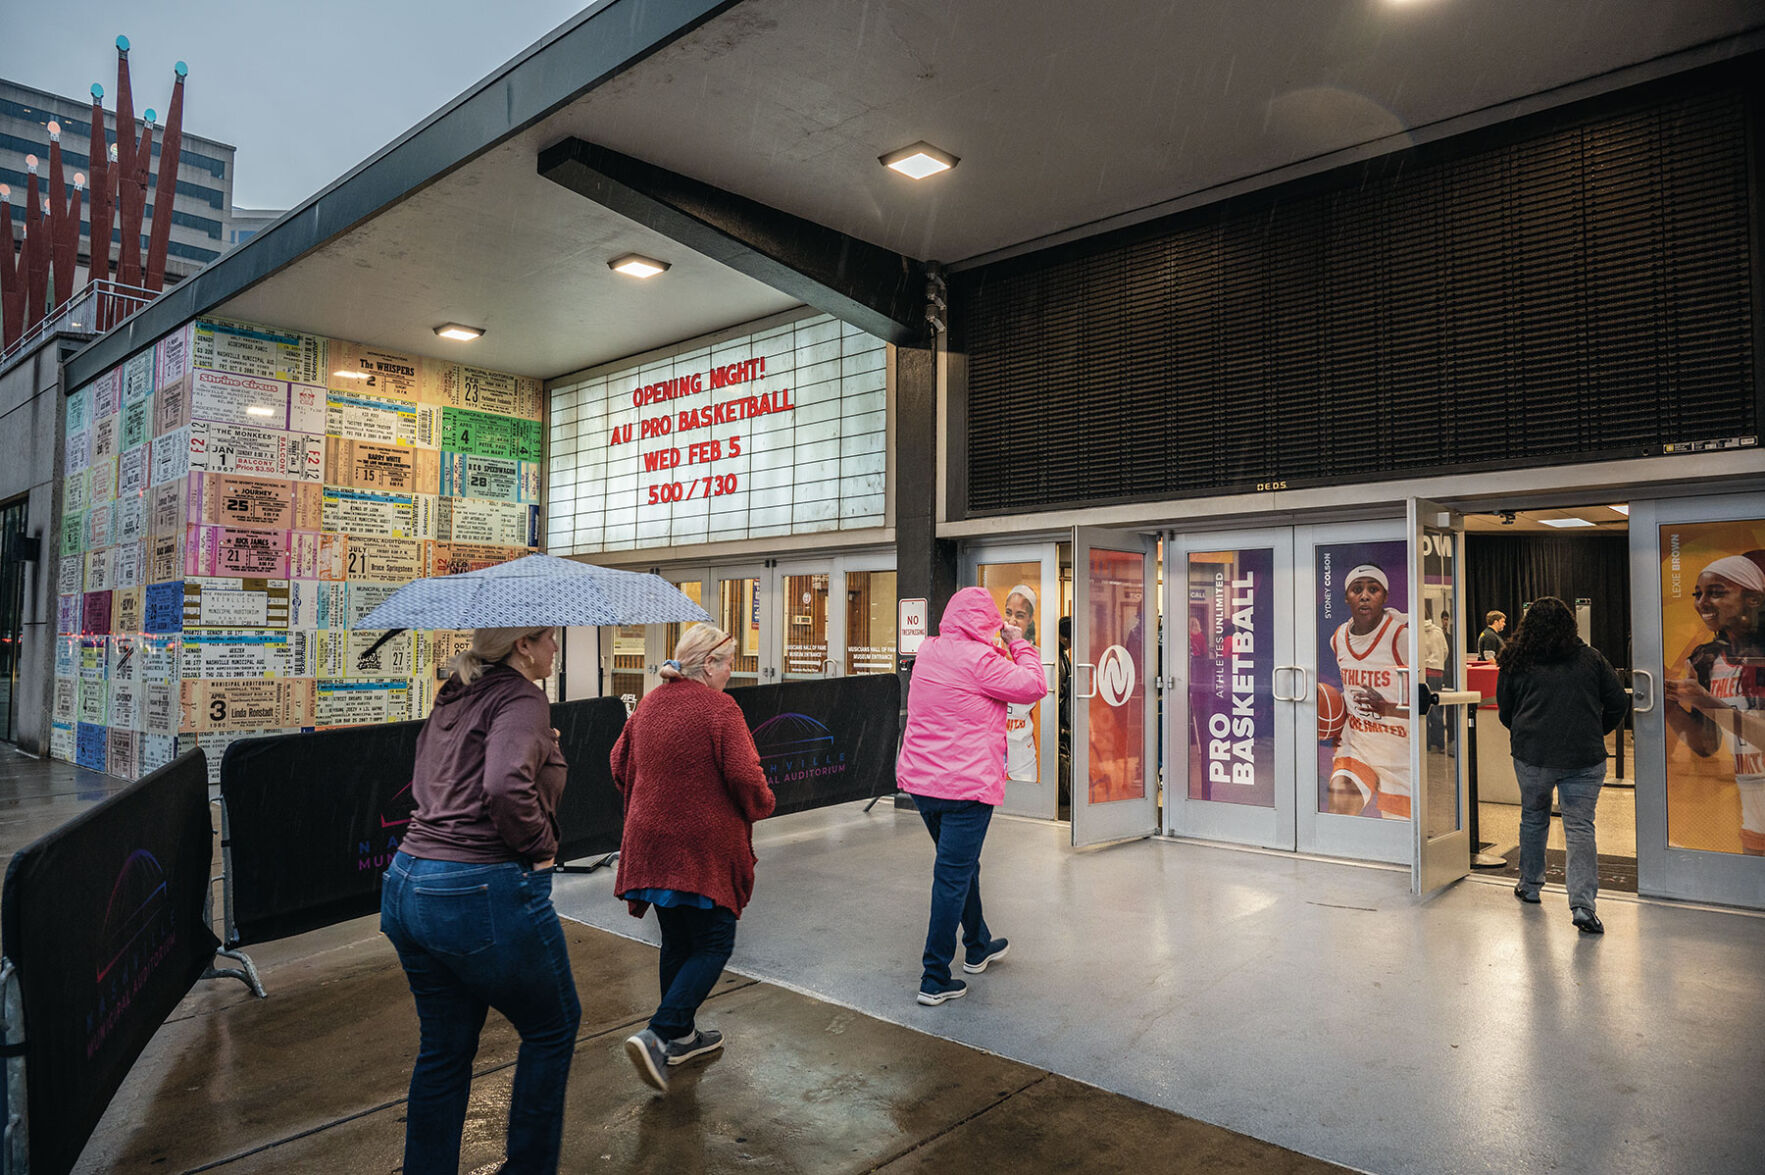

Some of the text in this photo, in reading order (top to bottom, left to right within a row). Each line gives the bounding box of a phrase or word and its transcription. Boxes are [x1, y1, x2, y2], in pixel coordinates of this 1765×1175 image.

[360, 358, 414, 376] The WHISPERS
[200, 373, 278, 392] Shrine Circus
[366, 376, 376, 386] 2
[465, 376, 479, 384] FEB
[632, 356, 766, 408] OPENING NIGHT!
[464, 382, 478, 402] 23
[610, 388, 795, 446] AU PRO BASKETBALL
[460, 430, 469, 444] 4
[212, 445, 234, 454] JAN
[644, 436, 741, 472] WED FEB 5
[219, 454, 226, 466] 1
[238, 458, 273, 466] BALCONY
[236, 464, 254, 472] Price
[364, 470, 374, 482] 15
[470, 476, 487, 487] 28
[227, 498, 248, 512] 25
[250, 538, 269, 546] JAMES
[228, 550, 240, 562] 21
[348, 552, 364, 573] 21
[386, 564, 413, 573] Springsteen
[1670, 533, 1682, 599] LEXIE BROWN
[907, 615, 919, 626] NO
[1215, 572, 1224, 698] ATHLETES UNLIMITED
[393, 652, 404, 666] 27
[1232, 570, 1256, 786] BASKETBALL
[210, 700, 226, 722] 3
[232, 707, 274, 718] Linda Ronstadt
[1208, 712, 1232, 784] PRO
[784, 764, 846, 783] AUDITORIUM
